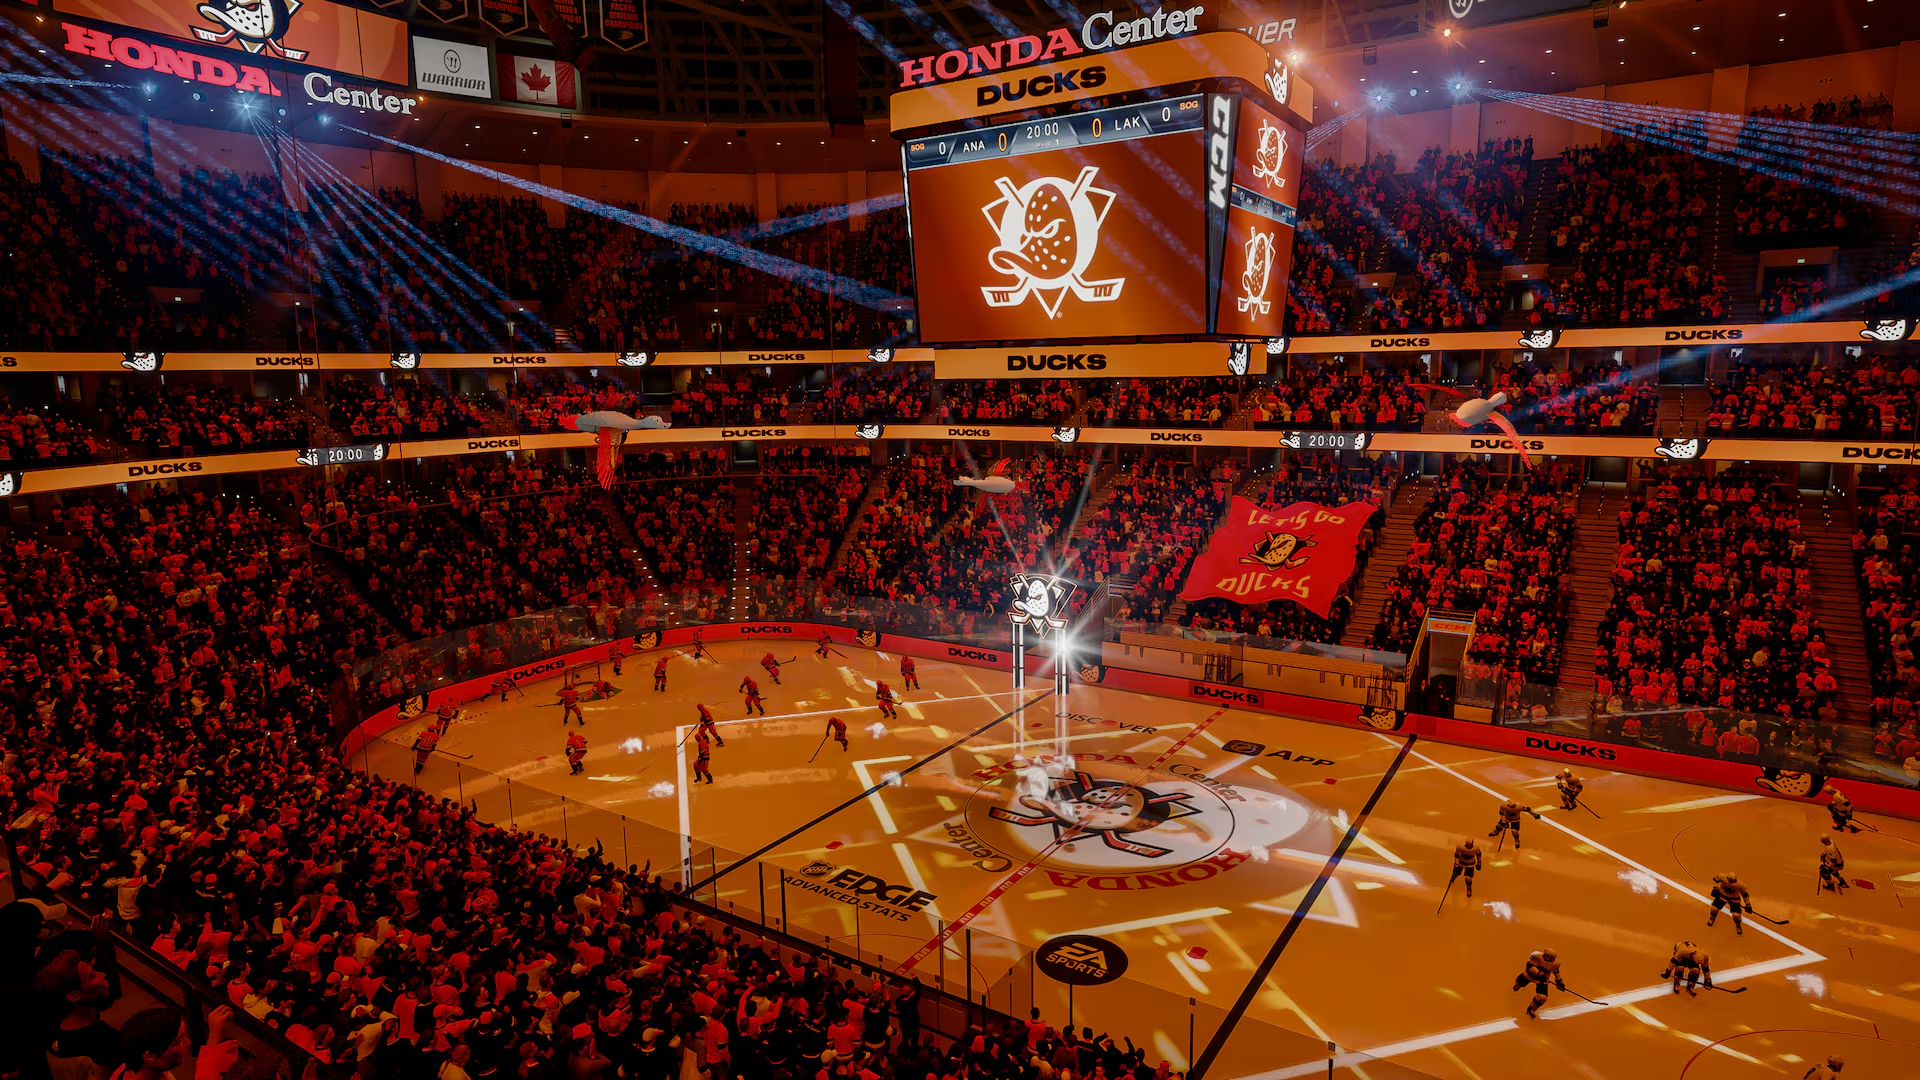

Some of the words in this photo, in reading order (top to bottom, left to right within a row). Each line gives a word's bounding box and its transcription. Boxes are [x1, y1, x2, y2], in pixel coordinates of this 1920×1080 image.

[610, 3, 636, 12] PACIFIC
[609, 11, 638, 21] DIVISION
[604, 19, 643, 30] CHAMPIONS
[900, 28, 1083, 87] HONDA
[1082, 6, 1204, 50] Center
[61, 22, 281, 96] HONDA
[304, 72, 417, 115] Center
[421, 72, 486, 91] WARRIOR
[976, 66, 1106, 107] DUCKS
[910, 143, 925, 151] SOG
[938, 141, 946, 155] 0
[962, 143, 985, 153] ANA
[998, 132, 1008, 152] 0
[1026, 122, 1060, 139] 20:00
[1092, 117, 1102, 138] 0
[1114, 116, 1140, 131] LAK
[1161, 106, 1171, 122] 0
[1179, 100, 1199, 110] SOG
[1209, 95, 1231, 210] CCM
[1370, 337, 1430, 348] DUCKS
[1664, 329, 1743, 341] DUCKS
[255, 356, 314, 366] DUCKS
[493, 356, 547, 365] DUCKS
[748, 353, 805, 361] DUCKS
[1007, 354, 1107, 371] DUCKS
[721, 429, 787, 438] DUCKS
[948, 428, 991, 437] DUCKS
[1150, 432, 1203, 442] DUCKS
[467, 439, 520, 450] DUCKS
[1308, 435, 1345, 448] 20:00
[328, 448, 363, 462] 20:00
[128, 462, 203, 477] DUCKS
[1313, 510, 1346, 526] GO
[1216, 572, 1311, 599] DUCKS
[741, 625, 793, 634] DUCKS
[1434, 623, 1467, 631] CCM
[947, 647, 998, 662] DUCKS
[512, 659, 566, 682] DUCKS
[1193, 685, 1259, 704] DUCKS
[1525, 736, 1617, 761] DUCKS
[1264, 750, 1336, 766] APP
[1168, 763, 1247, 802] Center
[943, 822, 1014, 873] Center
[1044, 847, 1251, 890] HONDA
[826, 868, 938, 913] EDGE
[783, 876, 861, 905] ADVANCED
[858, 901, 912, 922] STATS
[1053, 942, 1108, 971] EA
[1045, 953, 1107, 978] SPORTS
